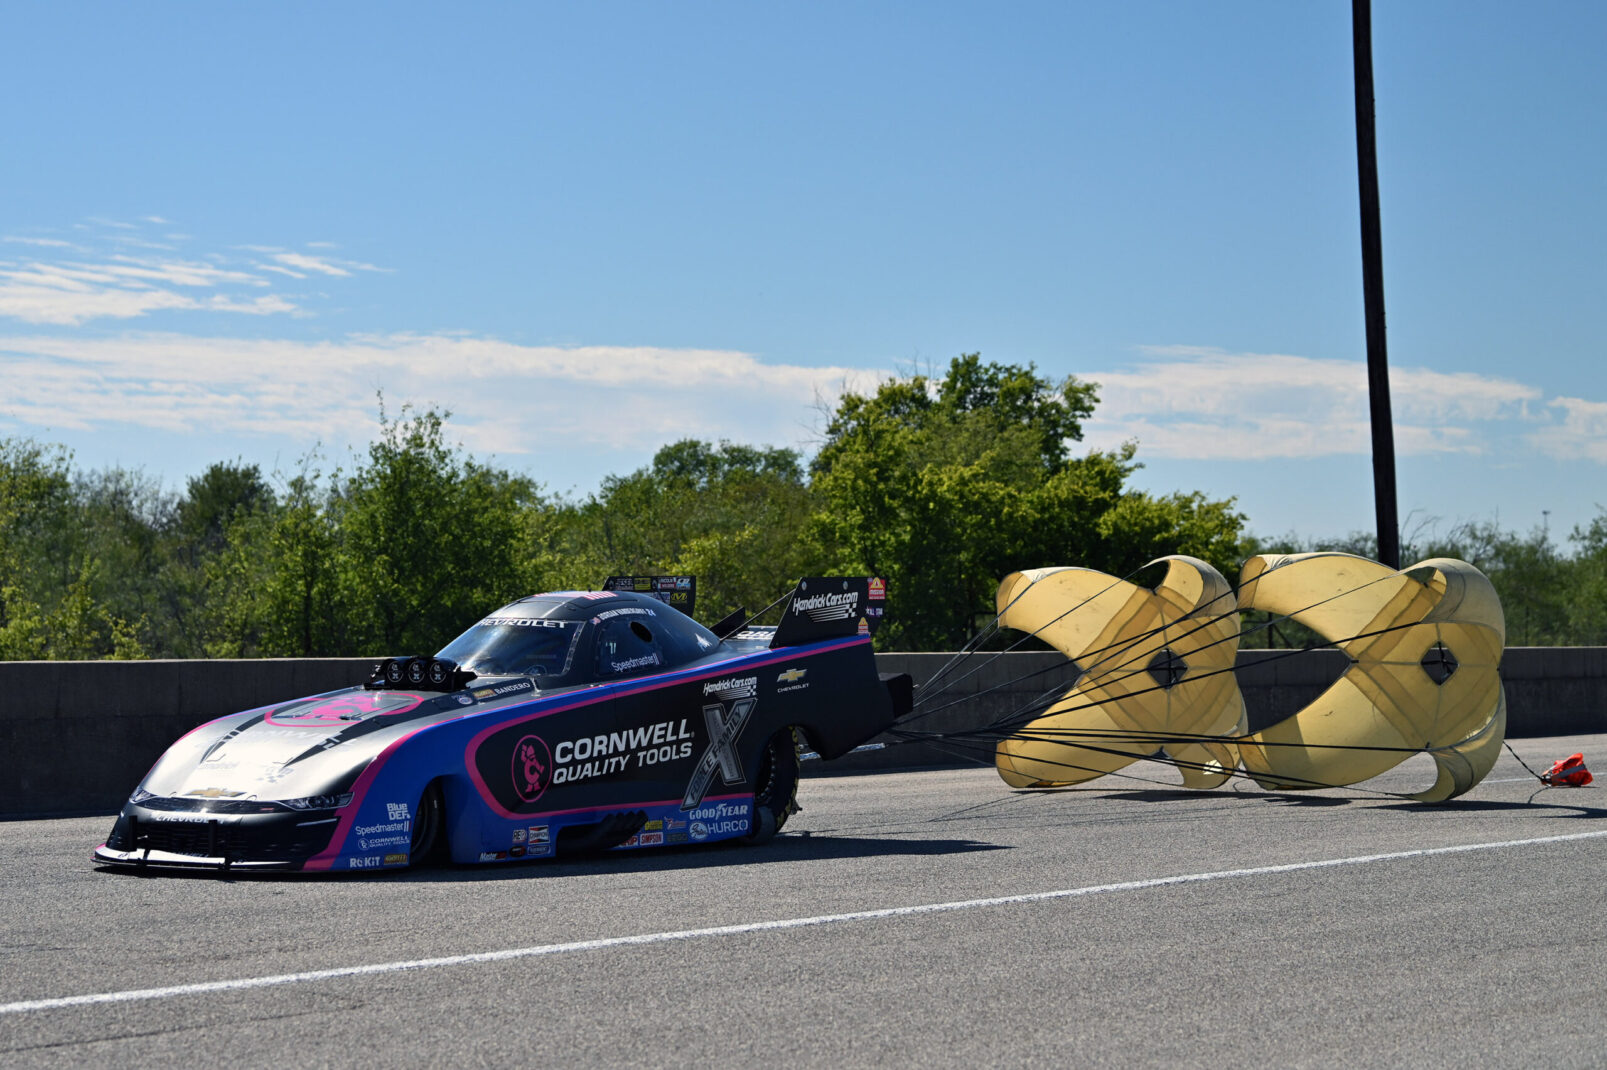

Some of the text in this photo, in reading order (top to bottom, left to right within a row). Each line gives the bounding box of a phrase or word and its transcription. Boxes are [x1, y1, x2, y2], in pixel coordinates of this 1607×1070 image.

[494, 682, 531, 695] BANDERO
[777, 683, 810, 693] CHEVROLET
[555, 719, 690, 764] CORNWELL
[553, 742, 692, 784] QUALITY TOOLS
[707, 819, 749, 834] HURCO
